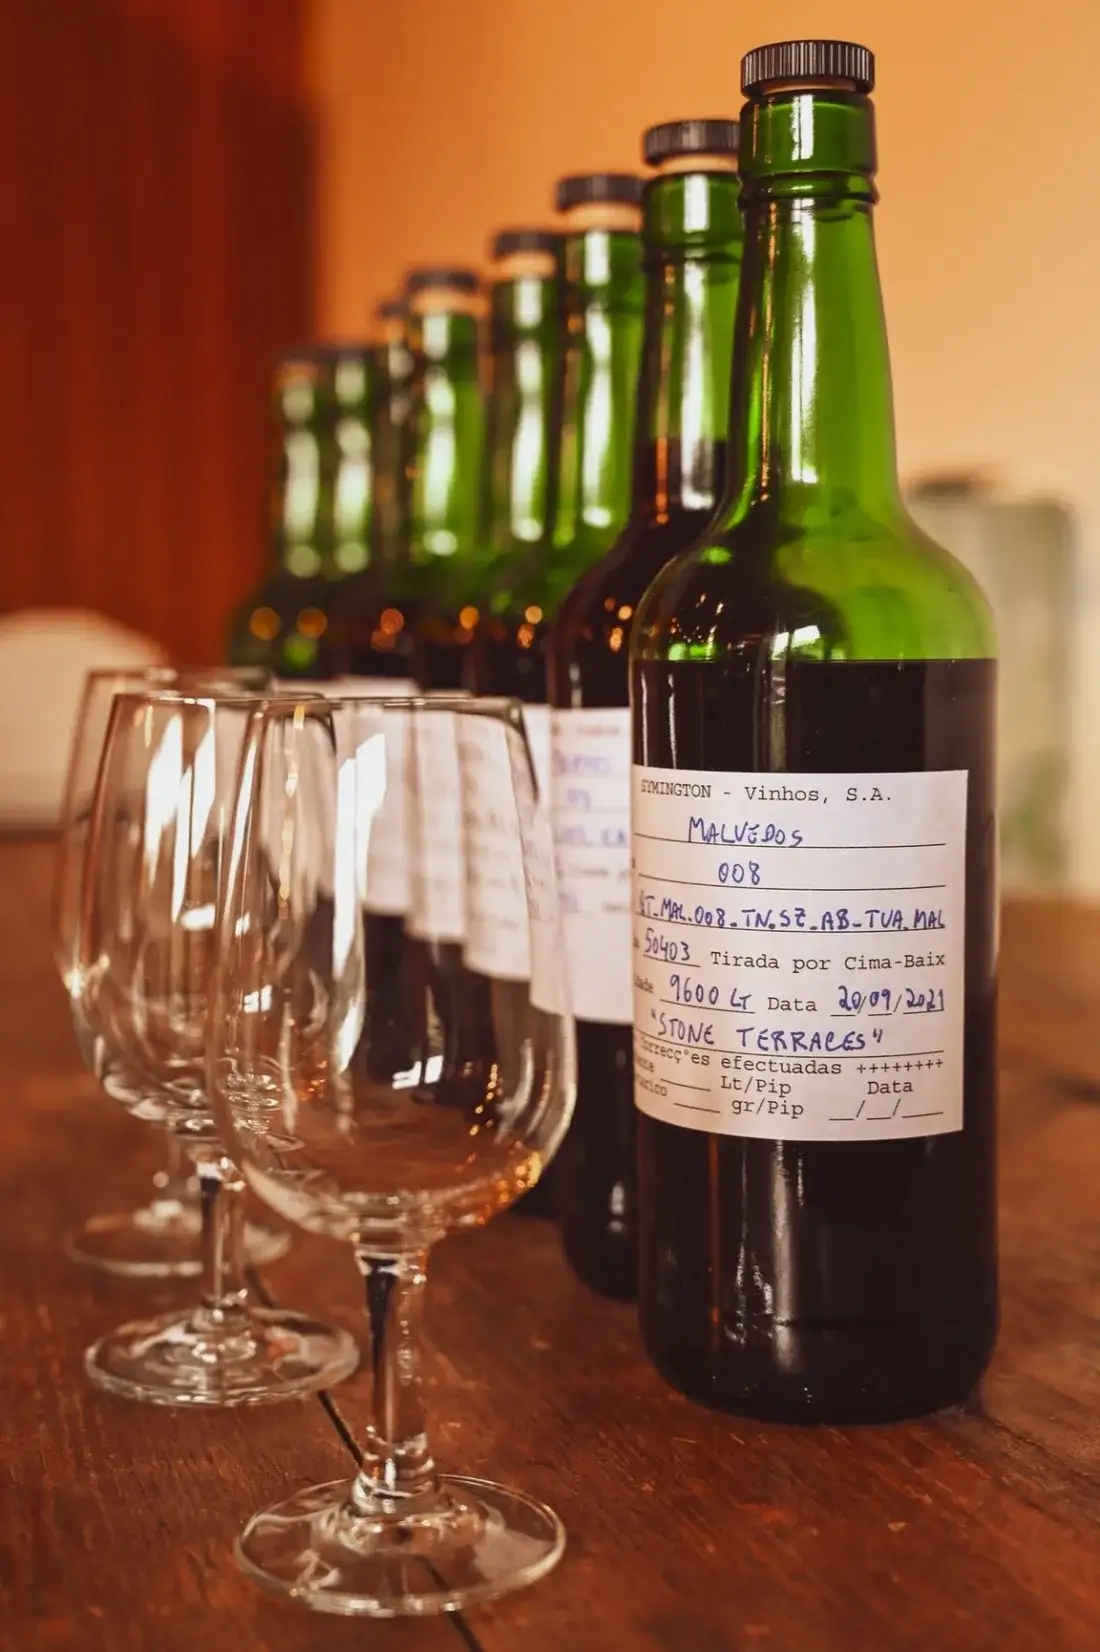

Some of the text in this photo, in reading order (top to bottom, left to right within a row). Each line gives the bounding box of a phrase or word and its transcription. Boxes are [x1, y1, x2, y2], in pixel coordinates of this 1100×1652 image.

[640, 778, 712, 799] SYMINGTON
[744, 786, 829, 804] Vinhos,
[846, 787, 892, 802] S.A.
[687, 816, 803, 848] MALVEDOS
[717, 860, 761, 886] 008
[644, 927, 691, 962] 50403
[710, 951, 946, 975] Tirada por Cima-Baix
[669, 974, 720, 1006] 9600
[838, 984, 945, 1015] 20/09/2021
[767, 996, 818, 1012] Data
[720, 1055, 842, 1075] efectuadas
[720, 1075, 914, 1098] Lt/Pip Data
[731, 1097, 804, 1119] gr/Pip
